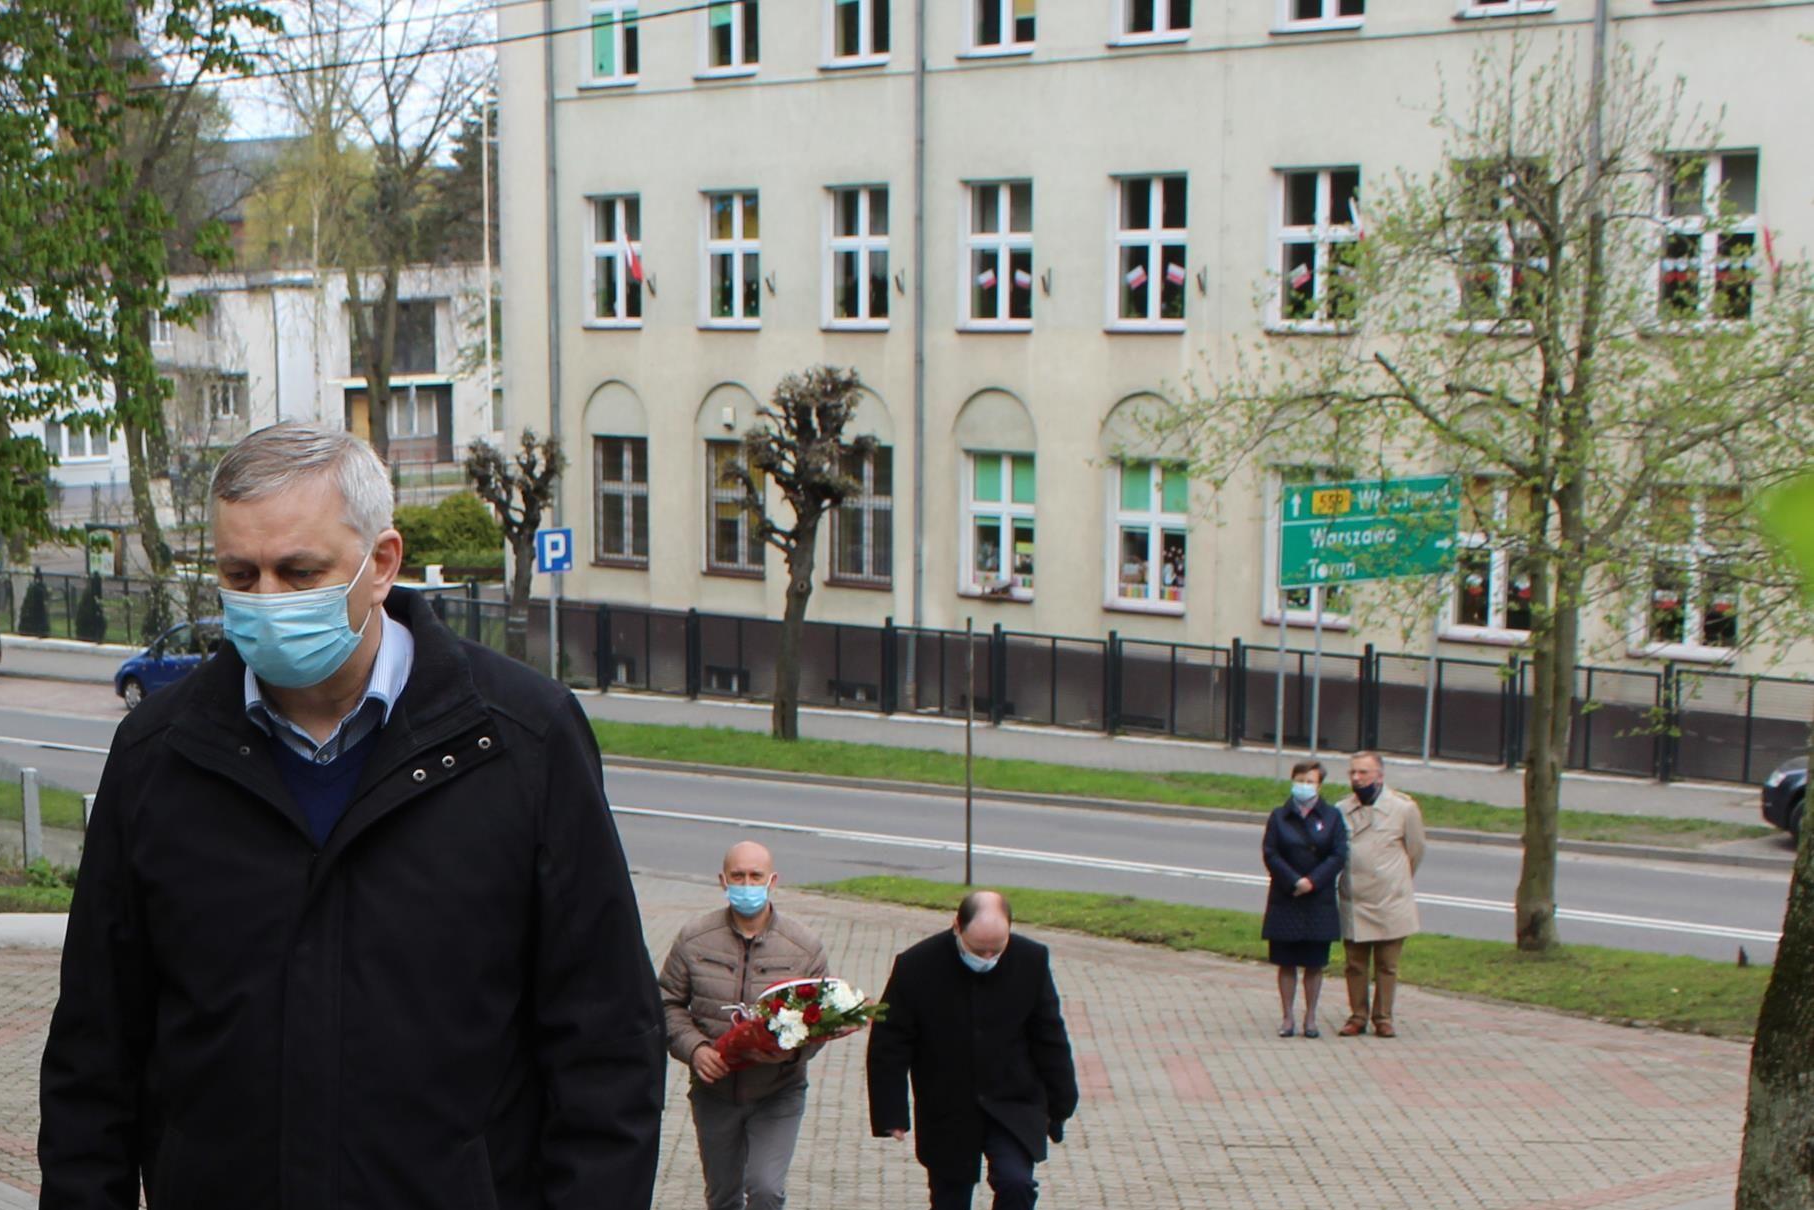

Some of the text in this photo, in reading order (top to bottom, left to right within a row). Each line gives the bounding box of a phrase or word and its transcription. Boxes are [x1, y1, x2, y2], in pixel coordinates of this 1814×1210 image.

[1357, 484, 1452, 511] Włcłwk
[544, 532, 566, 569] P
[1309, 526, 1397, 549] Warszawa
